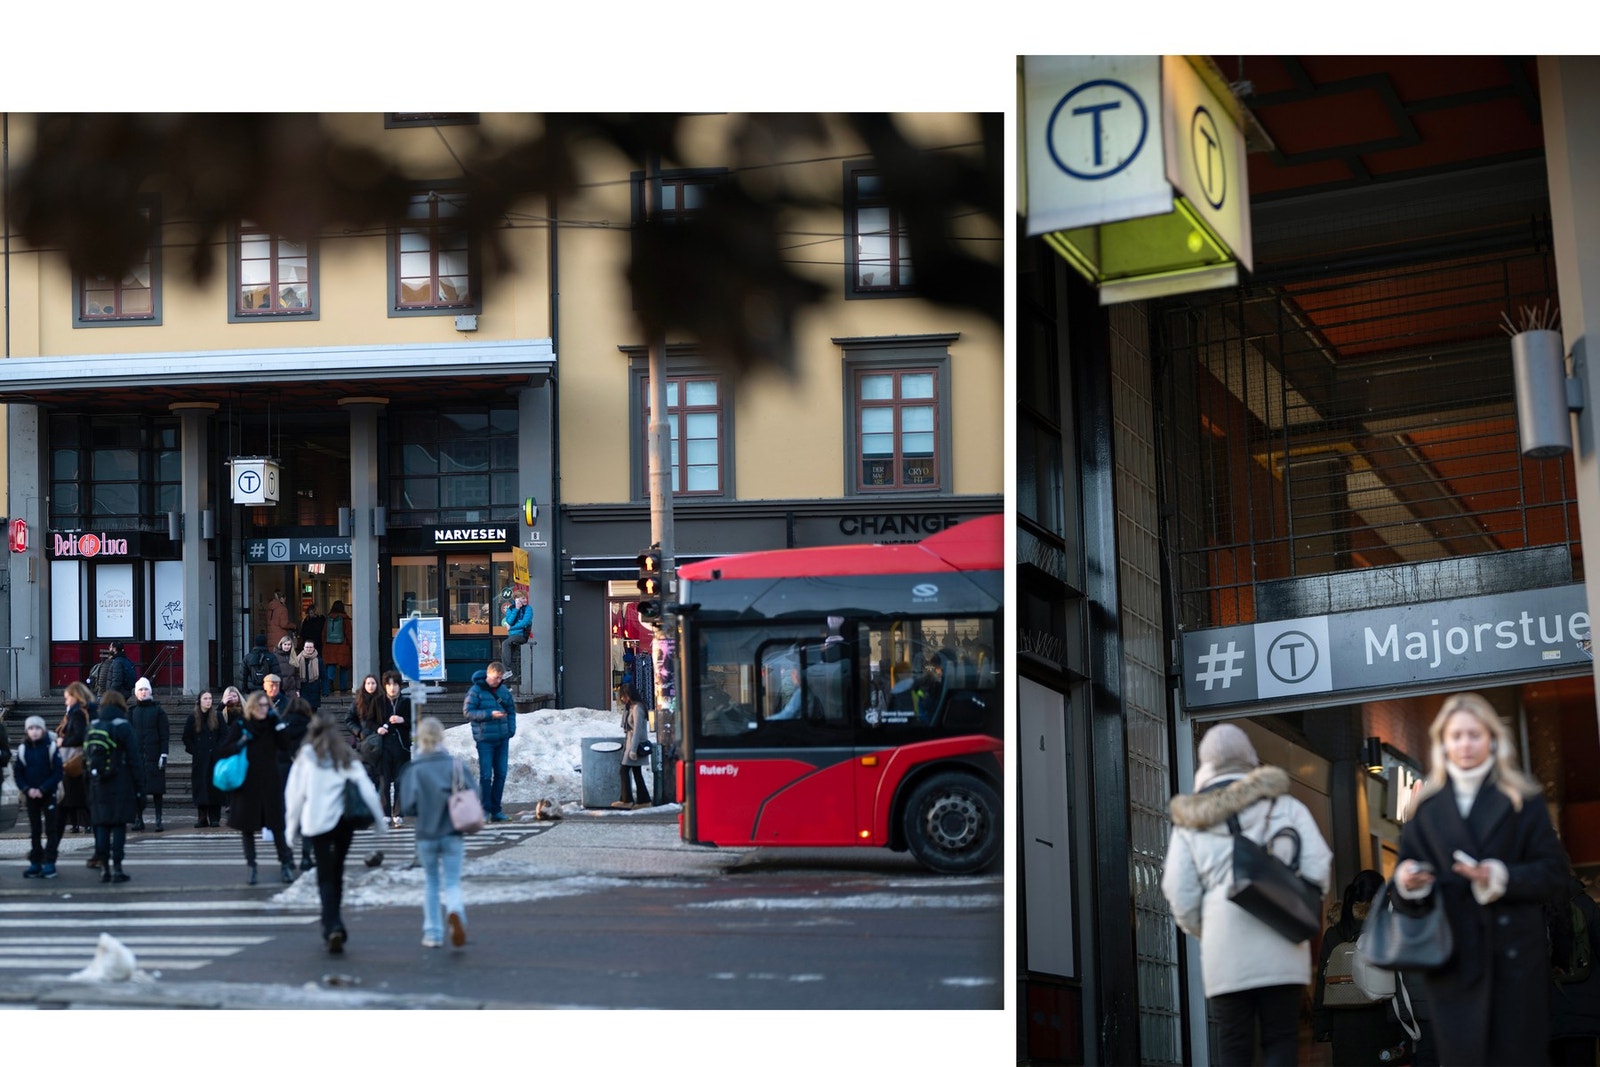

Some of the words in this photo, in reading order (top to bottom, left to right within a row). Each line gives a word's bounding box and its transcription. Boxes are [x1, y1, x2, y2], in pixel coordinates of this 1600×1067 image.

[839, 515, 959, 536] CHANGE
[435, 528, 506, 541] NARVESEN
[54, 533, 77, 556] Deli
[101, 532, 128, 556] Luca
[699, 765, 739, 777] RuterBy
